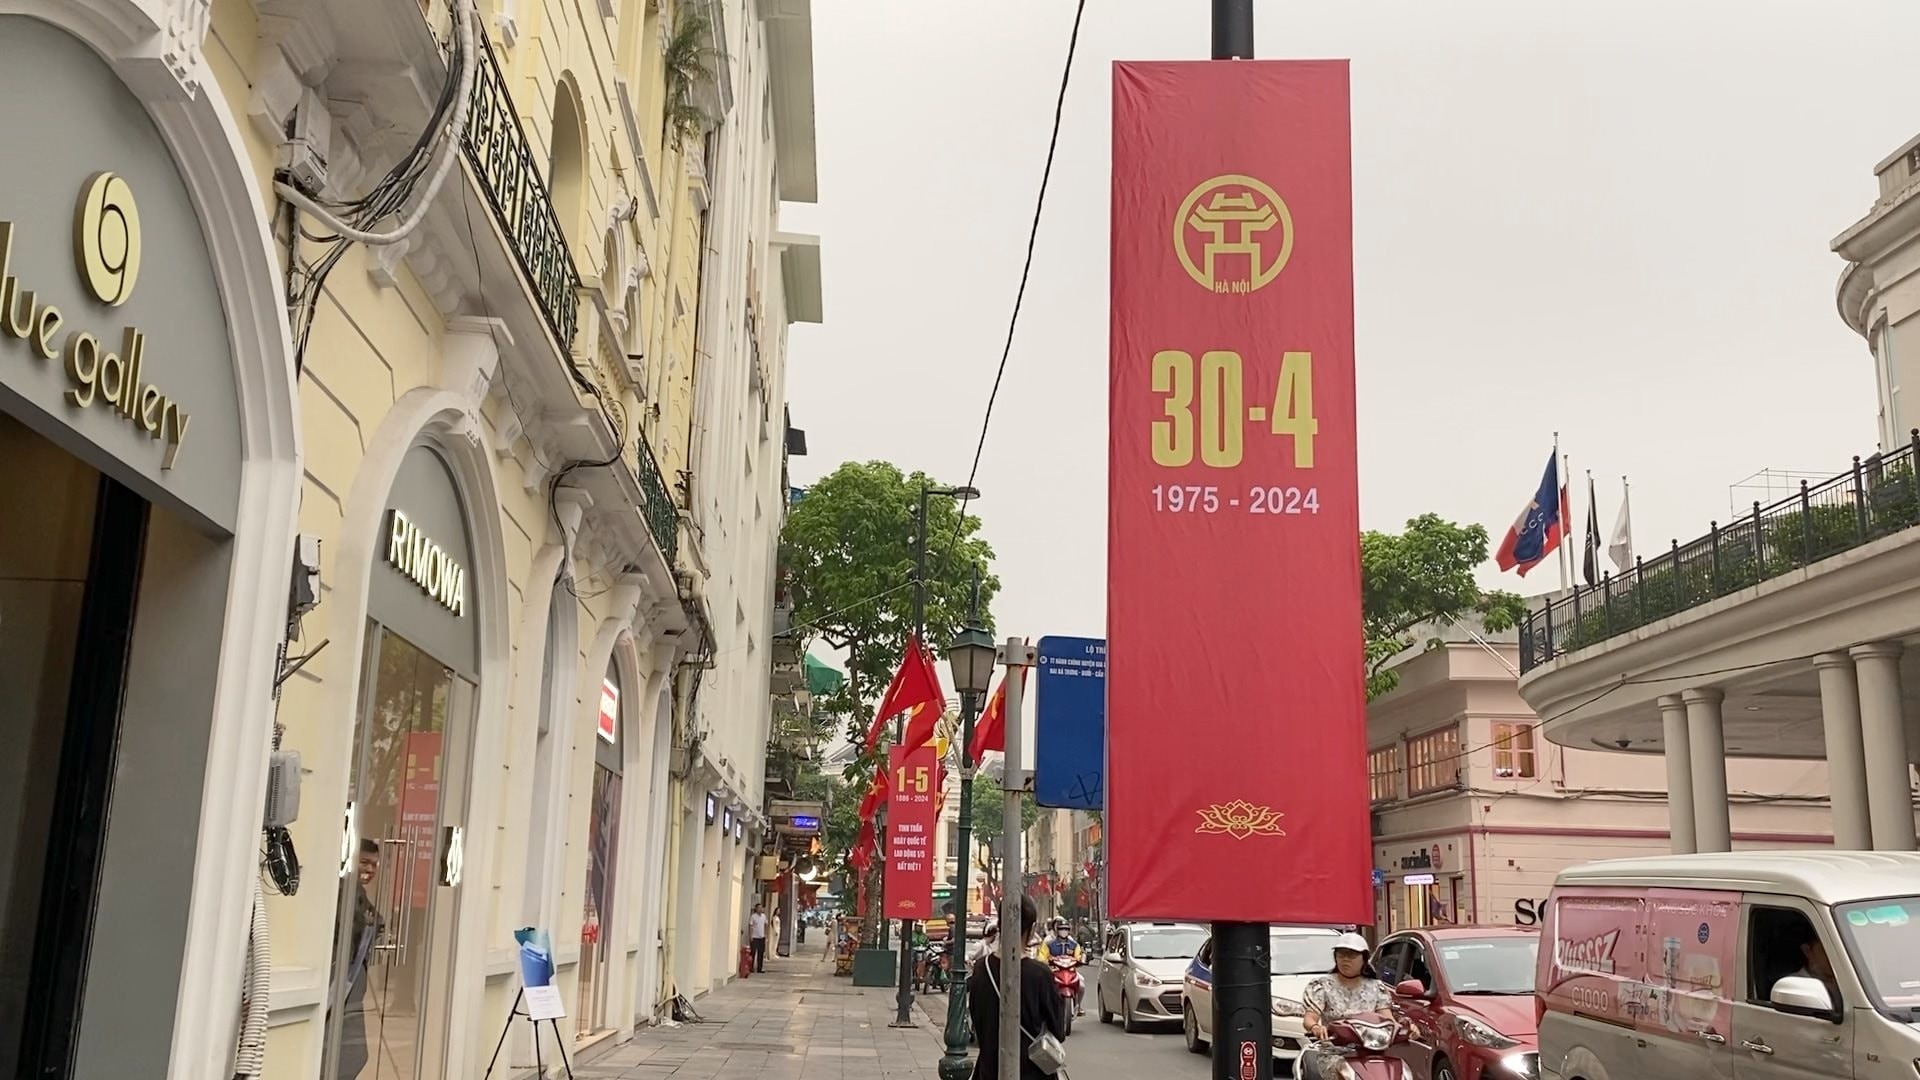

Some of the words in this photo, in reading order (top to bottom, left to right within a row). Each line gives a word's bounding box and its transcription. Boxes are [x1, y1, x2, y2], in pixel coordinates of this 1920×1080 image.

[1215, 279, 1229, 293] HÀ
[1232, 279, 1250, 296] NỘI
[64, 327, 190, 470] gallery
[1152, 350, 1318, 468] 30-4
[1152, 485, 1219, 512] 1975
[1250, 487, 1319, 514] 2024
[388, 509, 464, 617] RIMOWA
[897, 766, 928, 792] 1-5
[914, 794, 929, 802] 2024
[1572, 986, 1608, 1011] C1000
